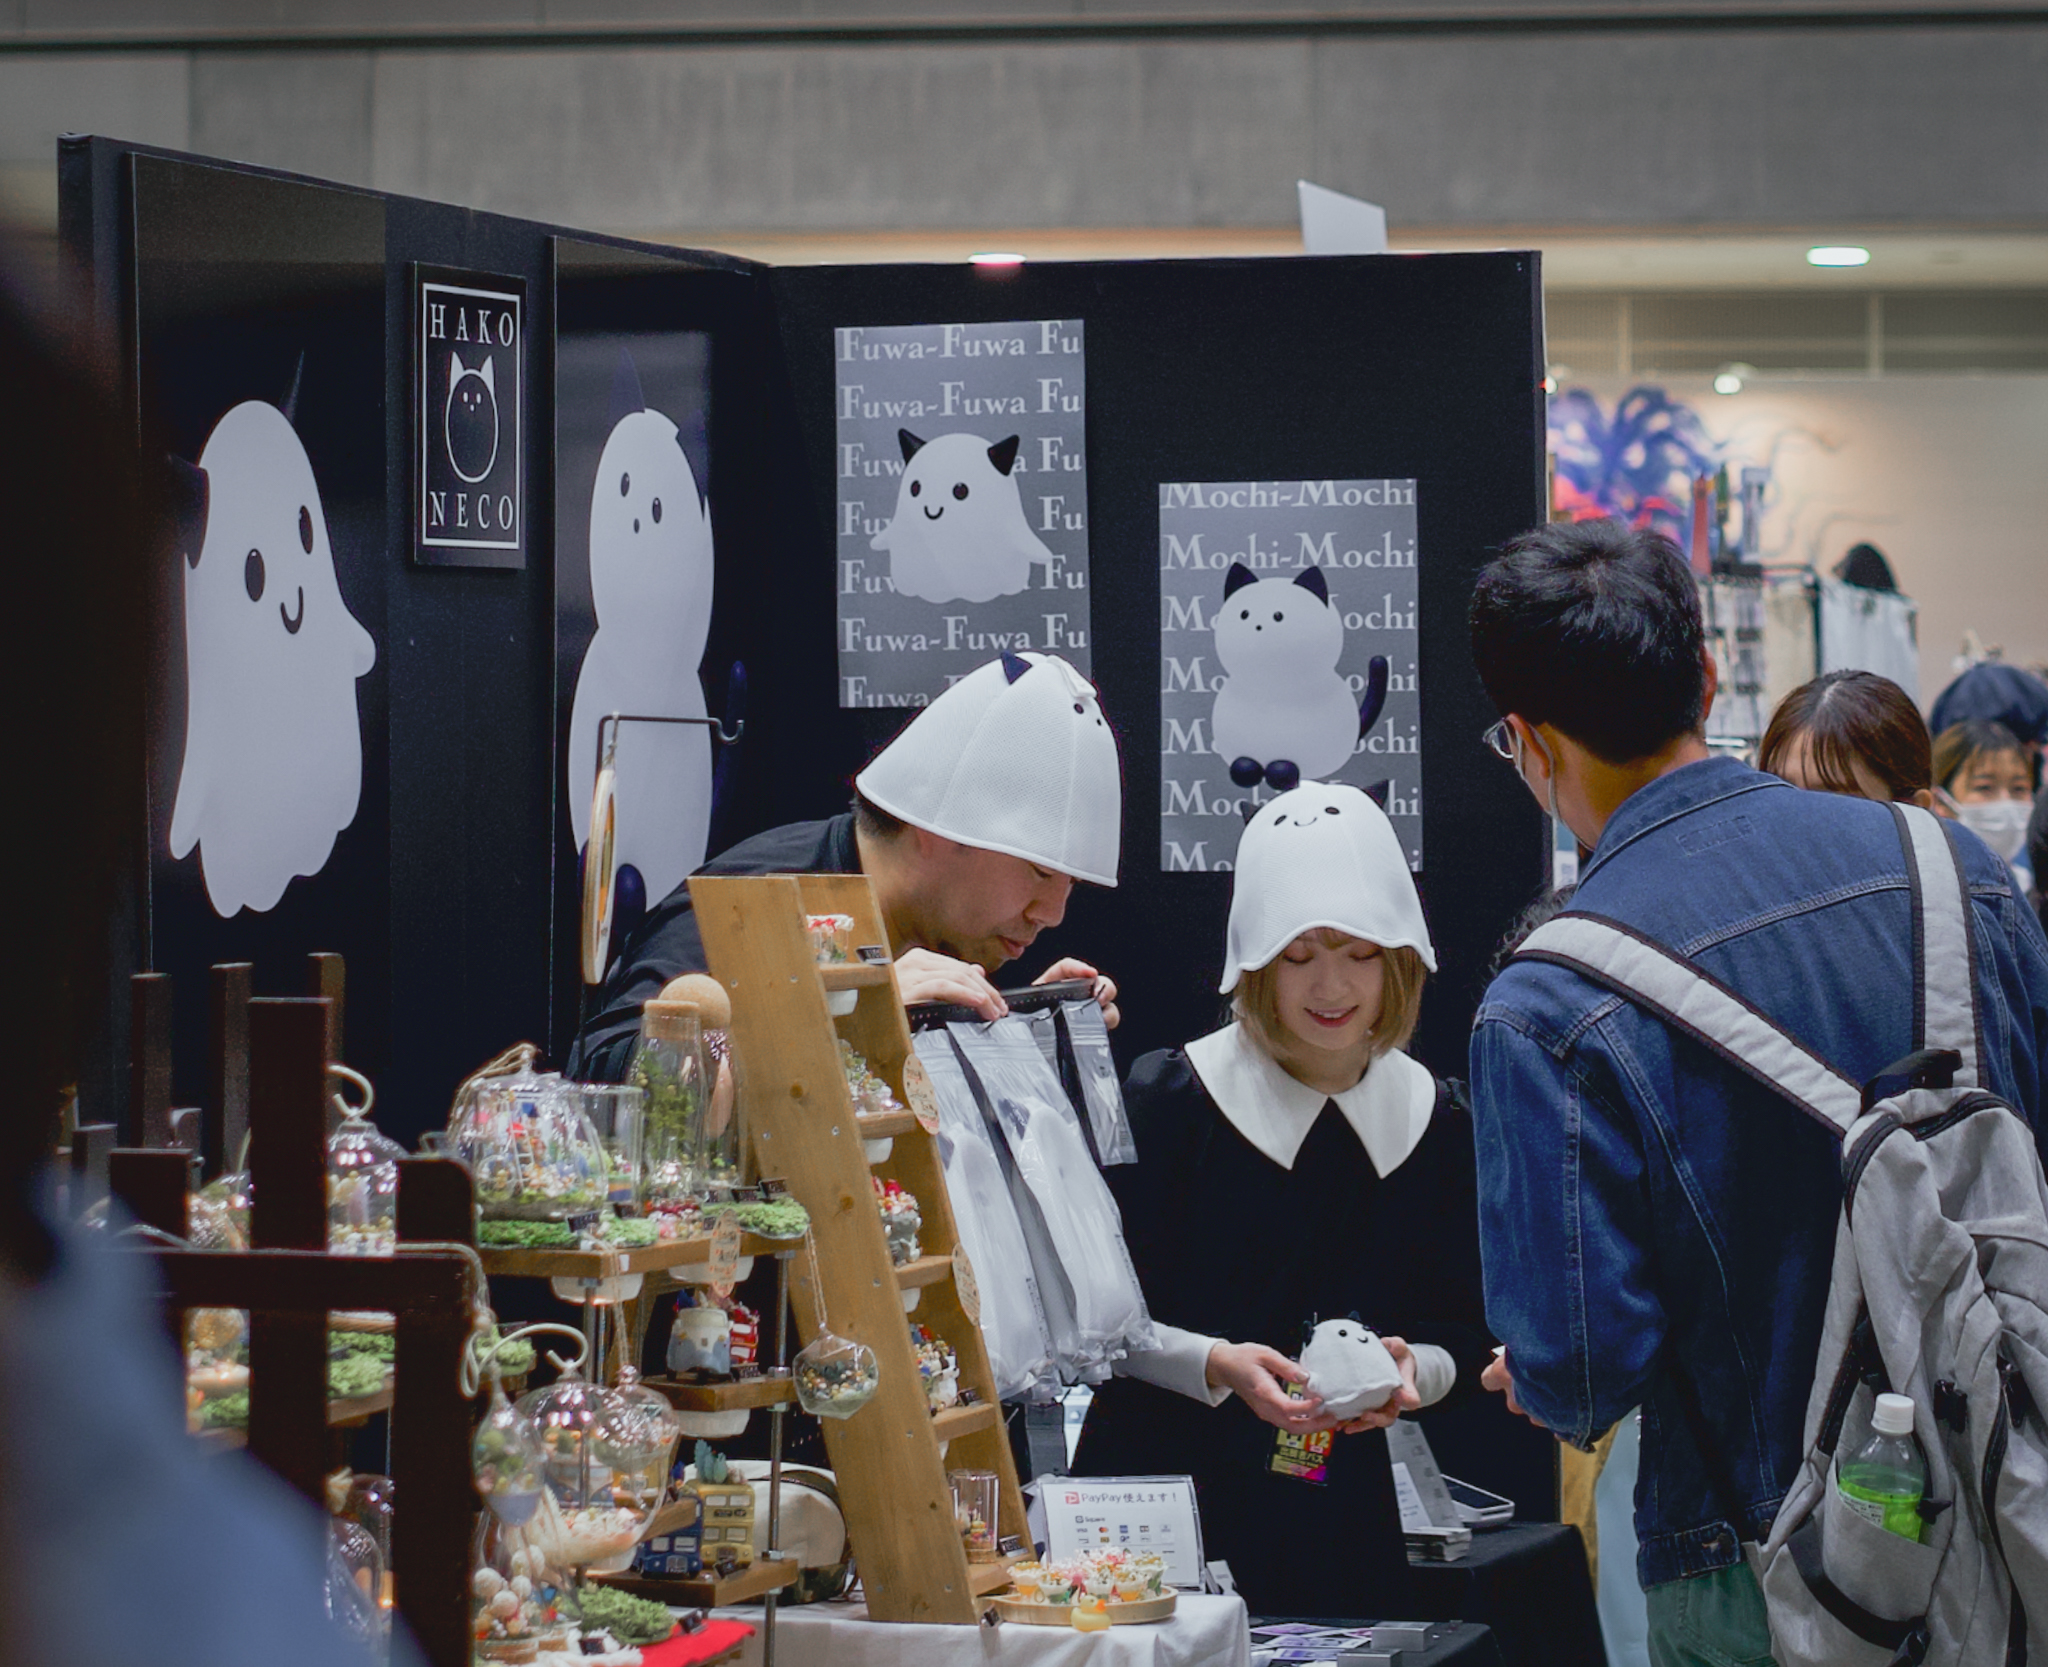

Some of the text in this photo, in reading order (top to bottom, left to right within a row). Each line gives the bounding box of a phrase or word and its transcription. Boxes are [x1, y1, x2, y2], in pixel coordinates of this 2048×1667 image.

[430, 303, 514, 346] HAKO
[838, 320, 1080, 362] Fuwa-Fuwa Fu
[839, 378, 1082, 420] Fuwa-Fuwa Fu
[1037, 436, 1083, 473] Fu
[429, 491, 514, 531] NECO
[1038, 495, 1084, 531] Fu
[1160, 479, 1416, 509] Mochi-Mochi
[1161, 531, 1417, 570] Mochi-Mochi
[1040, 554, 1086, 590] Fu
[840, 613, 1087, 653] Fuwa-Fuwa Fu
